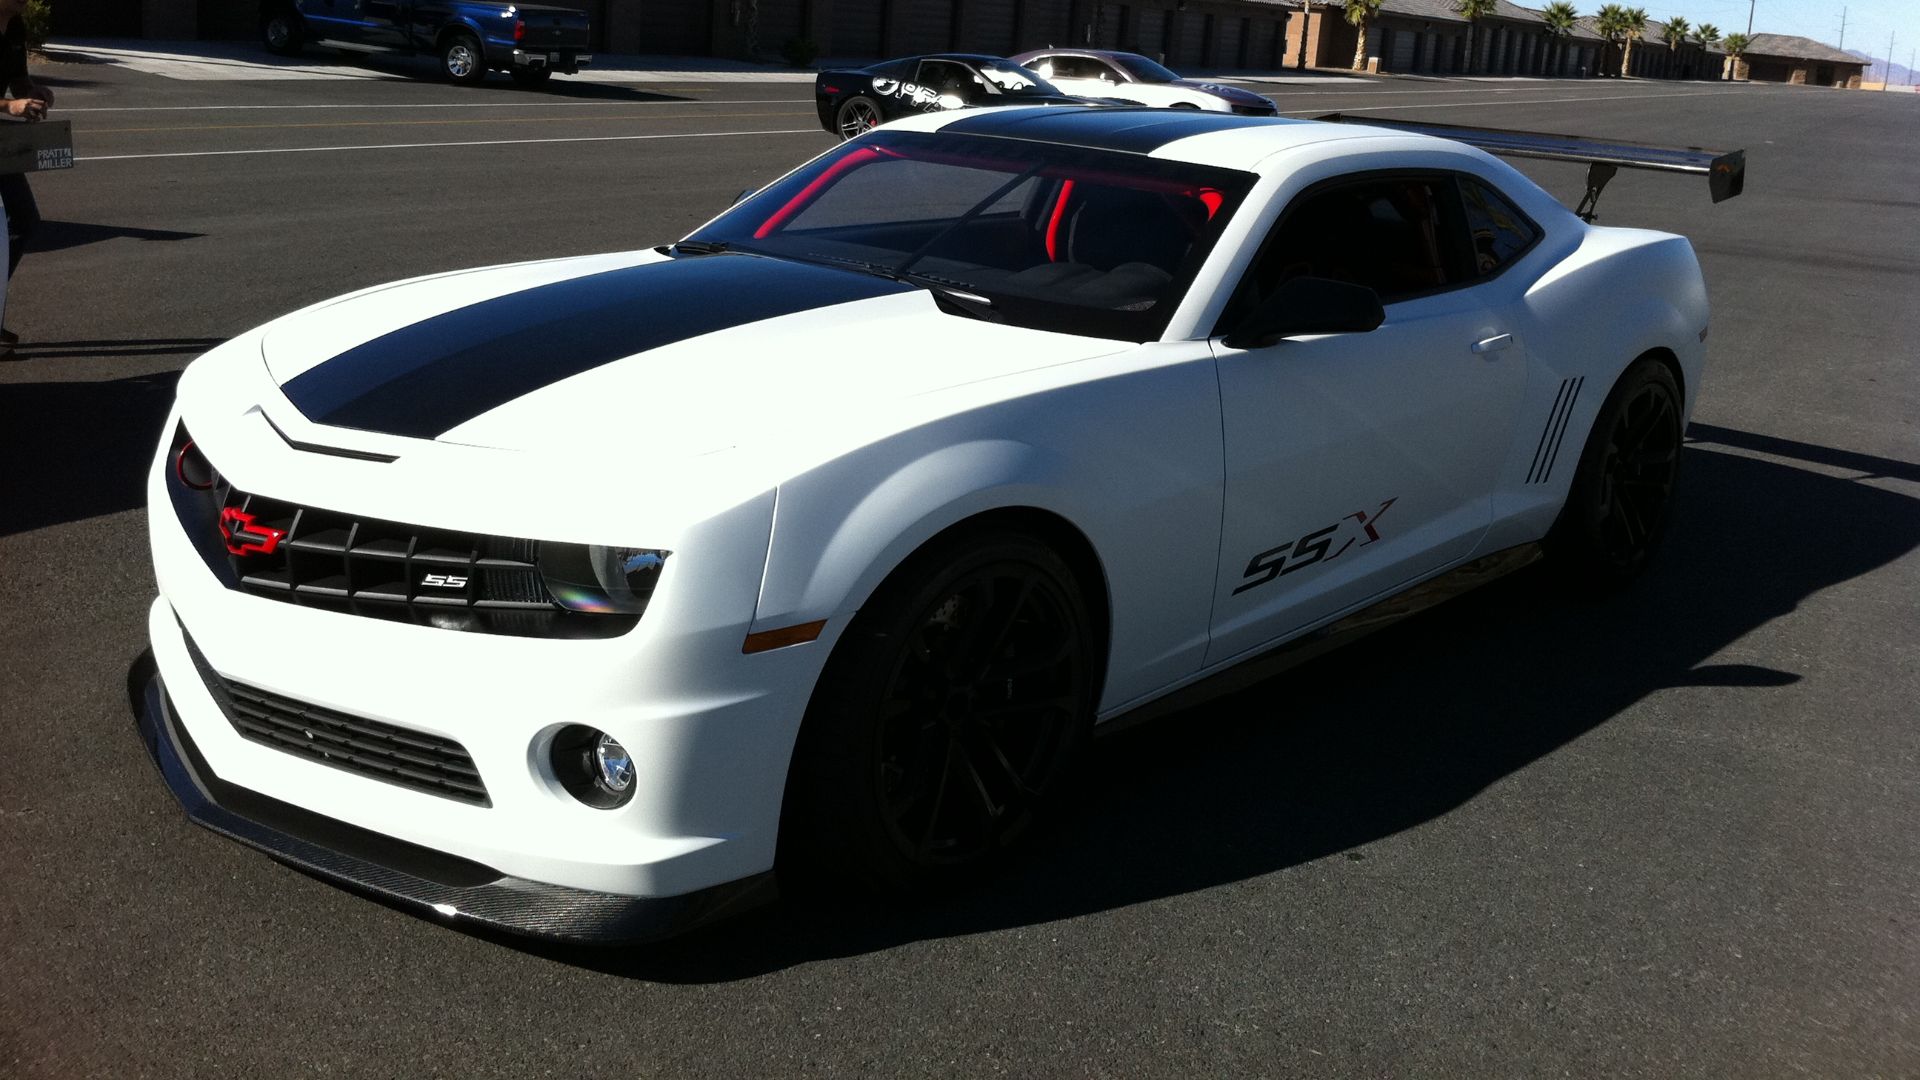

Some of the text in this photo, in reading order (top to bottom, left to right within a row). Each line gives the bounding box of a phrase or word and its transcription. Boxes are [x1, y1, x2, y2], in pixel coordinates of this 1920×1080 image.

[37, 148, 64, 159] PRATT
[38, 158, 72, 169] MILLER
[1232, 496, 1399, 596] SSX
[421, 574, 468, 588] SS
